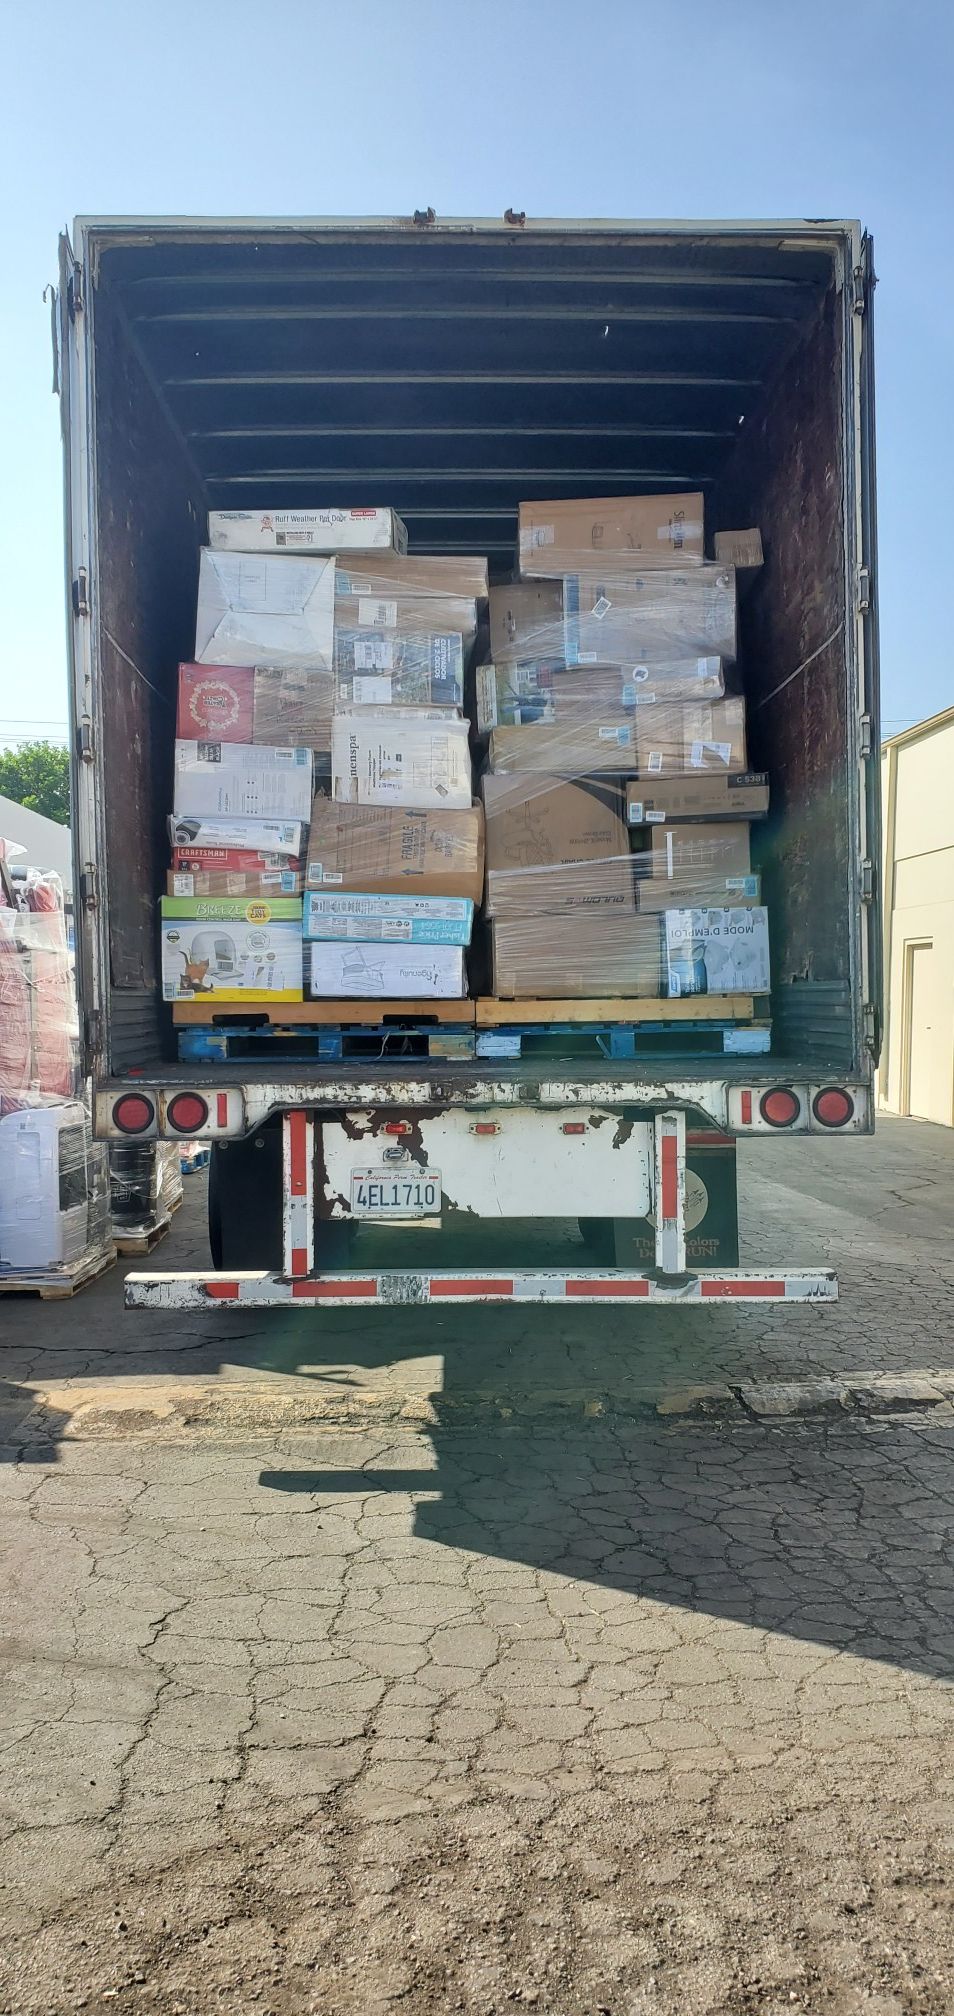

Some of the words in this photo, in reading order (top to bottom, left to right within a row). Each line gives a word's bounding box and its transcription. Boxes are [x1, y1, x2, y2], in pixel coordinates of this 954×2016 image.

[275, 515, 289, 523] Ruff
[290, 515, 317, 523] Weather
[401, 825, 414, 860] FRAGILE
[180, 848, 226, 857] CRAFTSMAN
[196, 902, 241, 916] BREEZE
[671, 927, 720, 938] D'EMPLOI
[723, 926, 754, 935] MODE
[365, 1173, 392, 1181] California
[356, 1184, 435, 1207] 4EL1710
